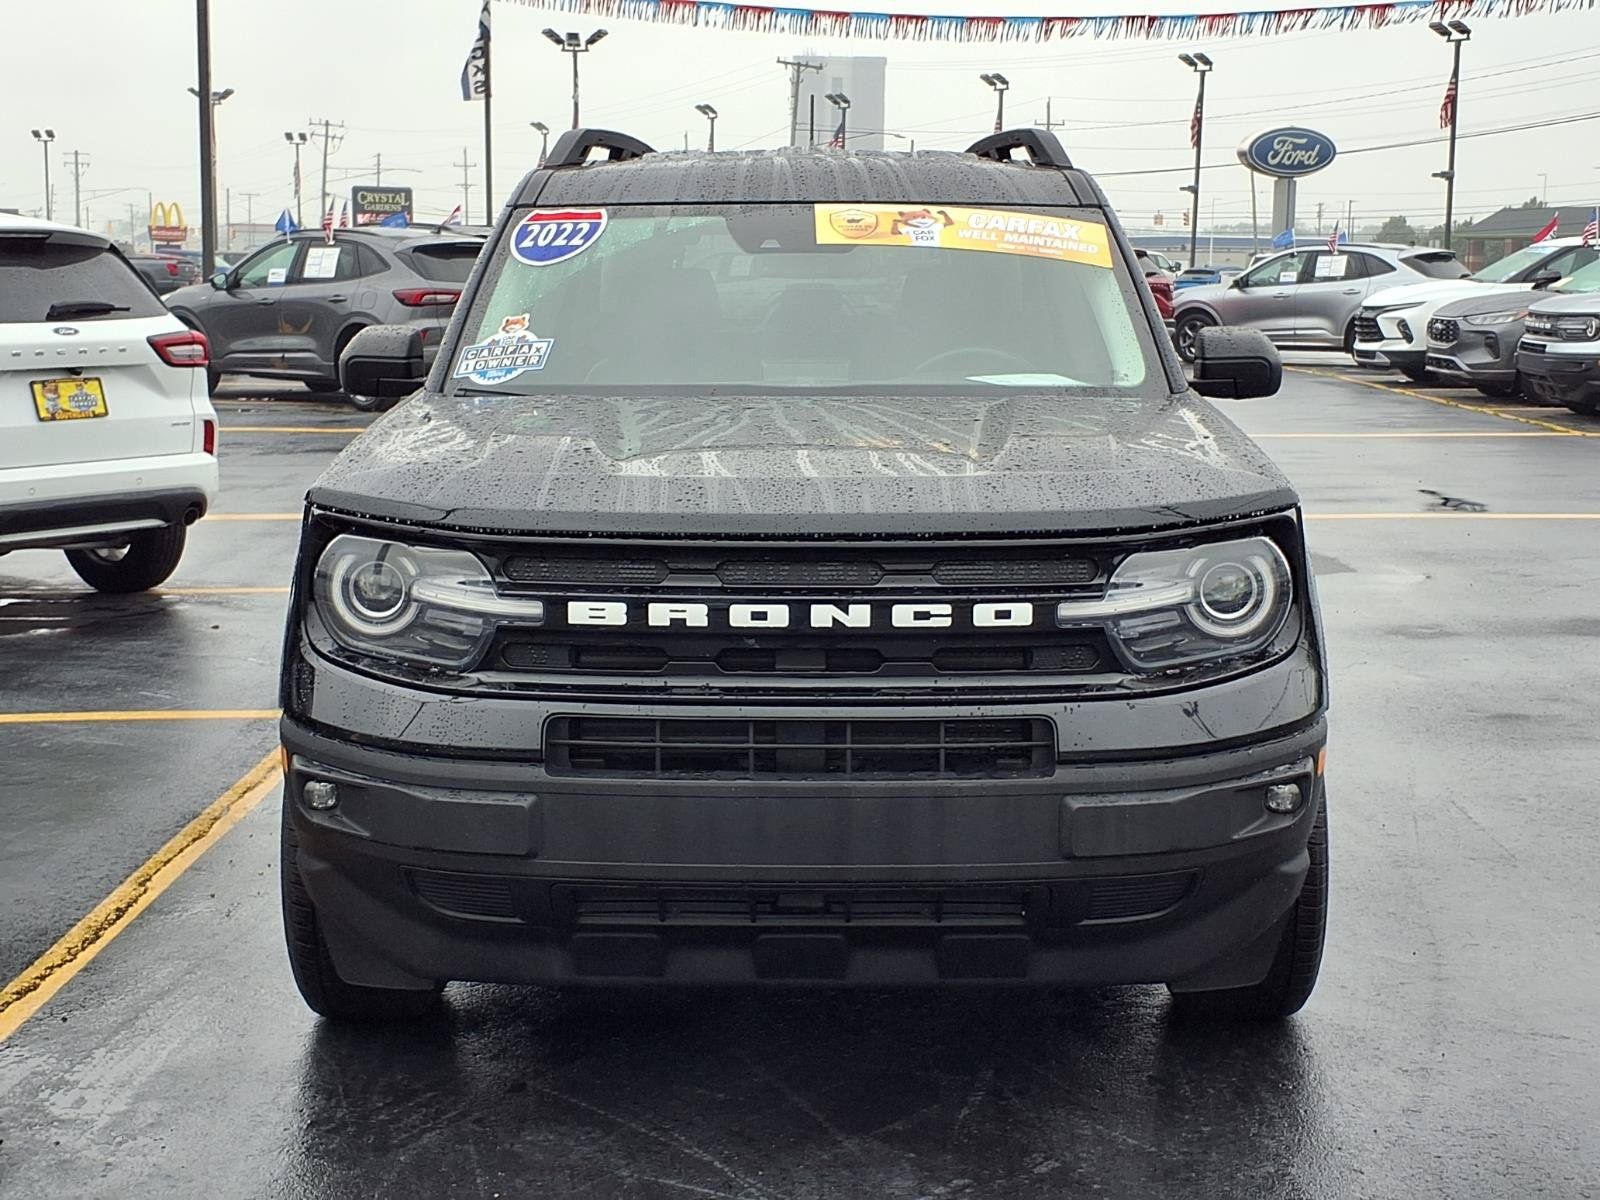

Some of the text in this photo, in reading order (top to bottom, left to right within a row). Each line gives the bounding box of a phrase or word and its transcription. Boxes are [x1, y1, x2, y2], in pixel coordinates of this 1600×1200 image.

[1267, 136, 1320, 166] Ford
[357, 191, 410, 206] CRYSTAL
[518, 223, 590, 248] 2022
[968, 213, 1081, 240] CARFAX
[958, 230, 998, 241] WELL
[1004, 234, 1098, 253] MAINTAINED
[467, 345, 543, 360] CARFAX
[475, 356, 540, 369] OWNER
[567, 601, 1033, 628] BRONCO
